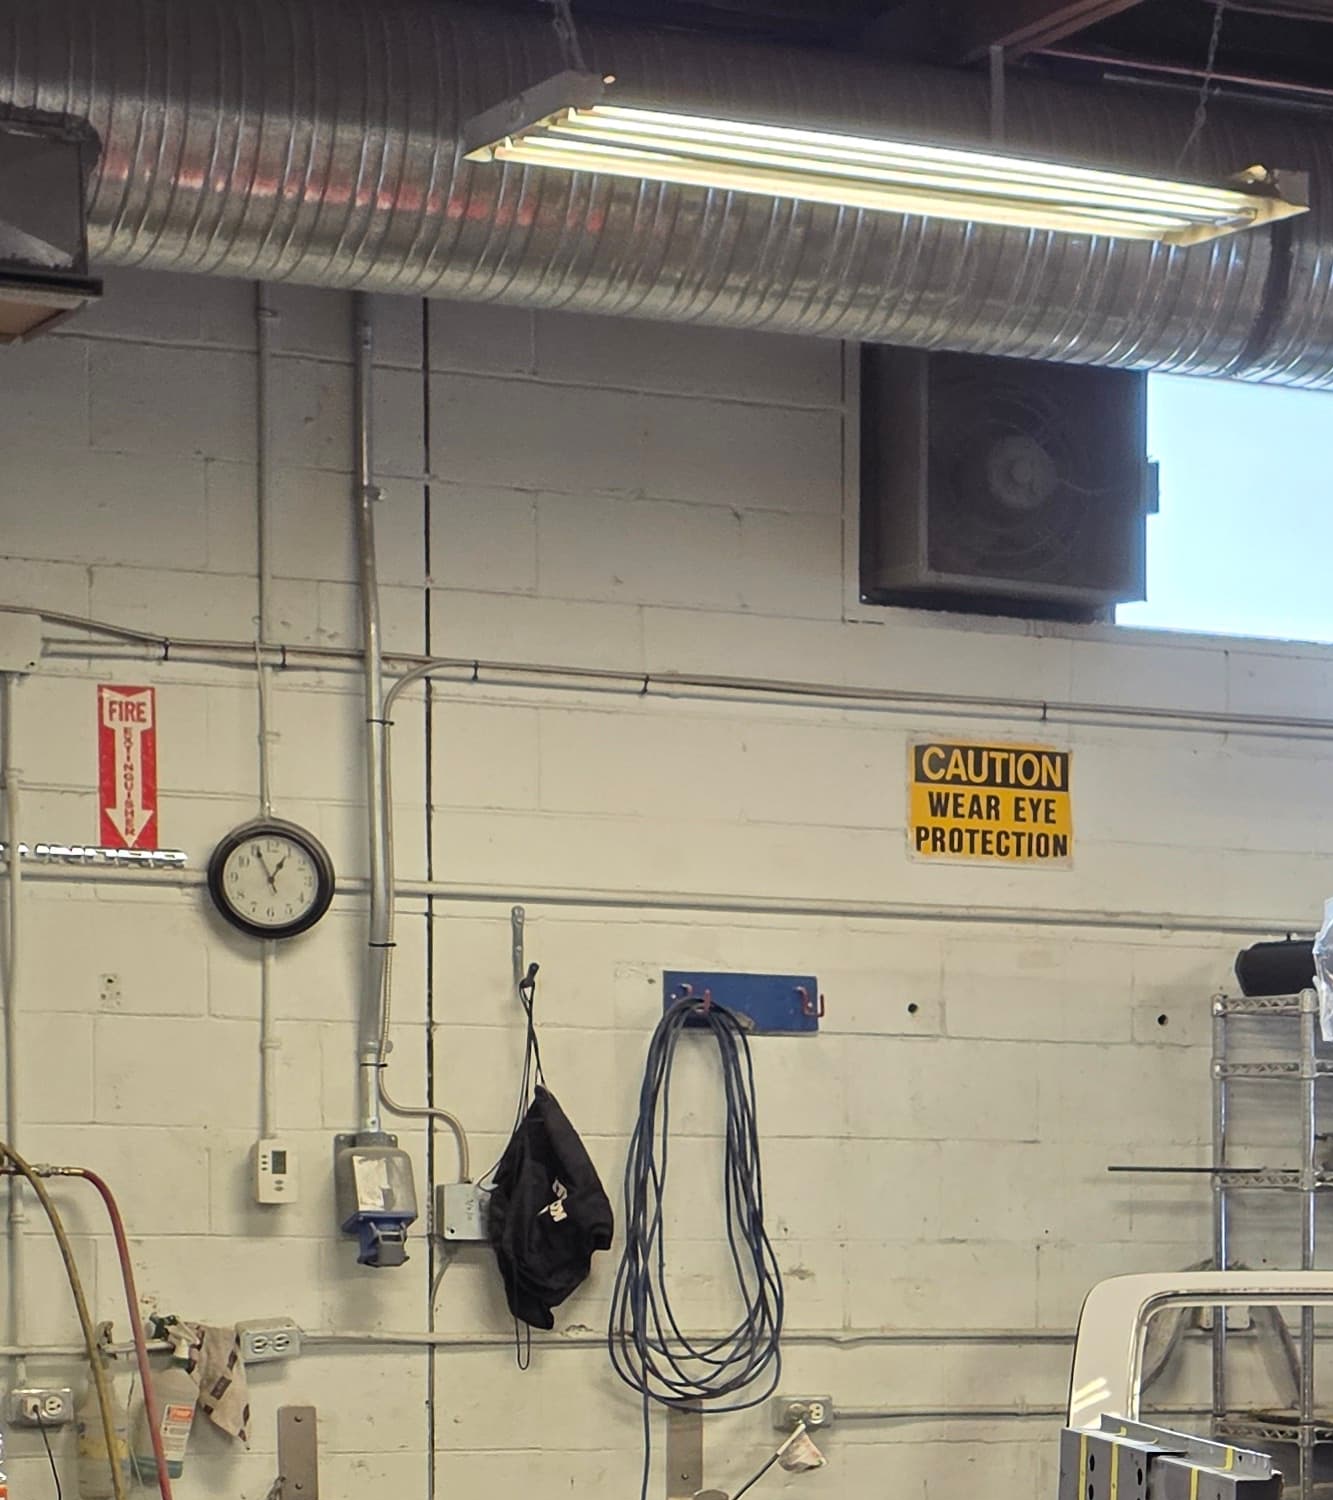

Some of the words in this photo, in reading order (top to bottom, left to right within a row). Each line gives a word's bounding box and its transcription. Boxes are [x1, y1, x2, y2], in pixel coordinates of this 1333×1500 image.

[109, 700, 147, 722] FIRE
[123, 727, 135, 836] EXTINGUISHER
[922, 747, 1062, 787] CAUTION
[928, 791, 1000, 821] WEAR
[1014, 796, 1056, 824] EYE
[916, 826, 1068, 857] PROTECTION
